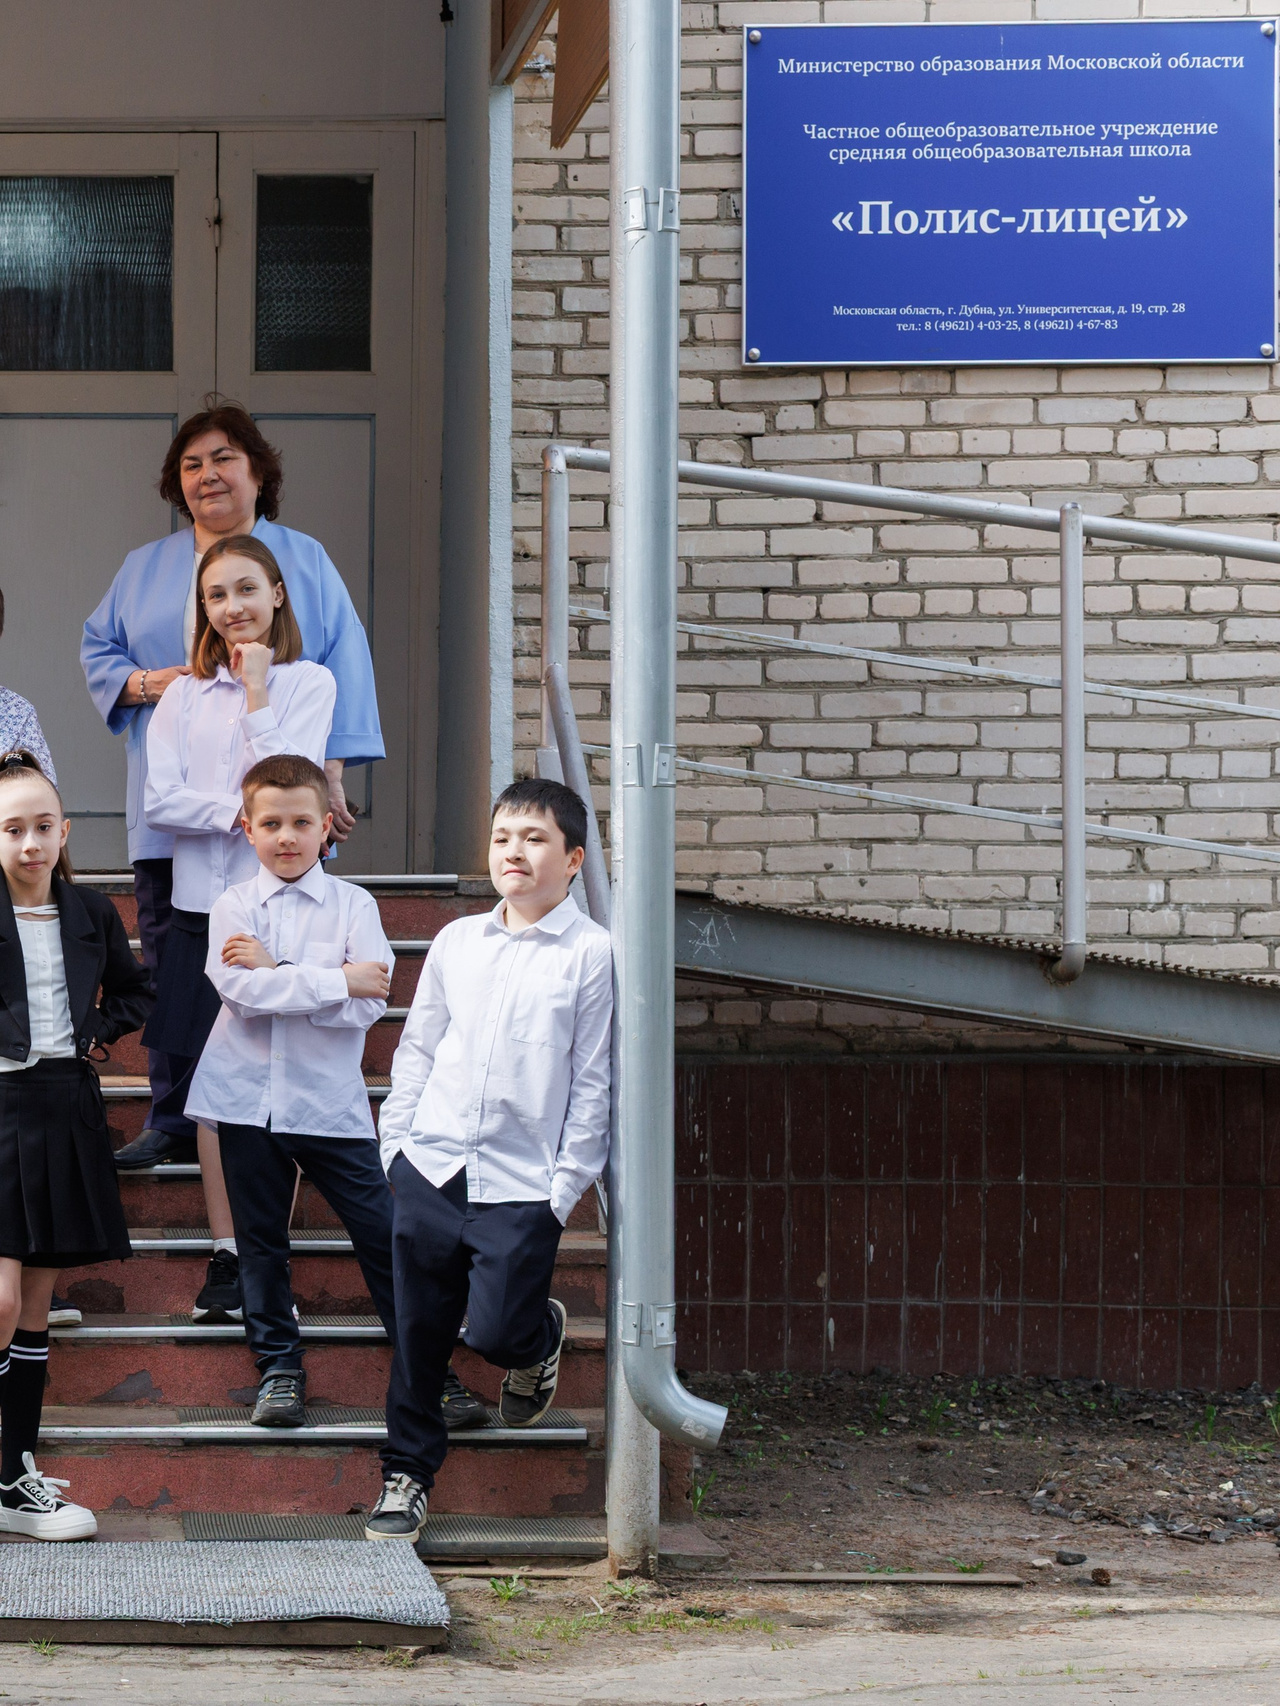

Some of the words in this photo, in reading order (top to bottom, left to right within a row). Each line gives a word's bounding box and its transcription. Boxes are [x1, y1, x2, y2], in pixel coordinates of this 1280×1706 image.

[778, 58, 915, 77] Министерство
[920, 55, 1042, 76] образования
[1047, 52, 1163, 70] Московской
[1167, 51, 1245, 69] области
[802, 124, 880, 139] Частное
[885, 121, 1096, 142] общеобразовательное
[1100, 122, 1219, 141] учреждение
[829, 148, 907, 165] средняя
[912, 142, 1124, 163] общеобразовательная
[1129, 144, 1192, 157] школа
[831, 195, 1189, 240] «Полис-лицей»
[832, 305, 897, 316] Московская
[899, 304, 946, 316] область,
[947, 305, 958, 316] г.
[958, 304, 997, 318] Дубна,
[997, 306, 1016, 317] ул.
[1017, 304, 1116, 317] Университетская,
[1116, 305, 1129, 315] д.
[1130, 303, 1147, 315] 19,
[1147, 305, 1170, 316] стр.
[1170, 302, 1187, 313] 28
[895, 321, 922, 332] тел.:
[923, 320, 933, 331] 8
[933, 319, 976, 332] (49621)
[975, 320, 1022, 332] 4-03-25,
[1022, 320, 1032, 331] 8
[1032, 318, 1075, 331] (49621)
[1075, 319, 1119, 330] 4-67-83
